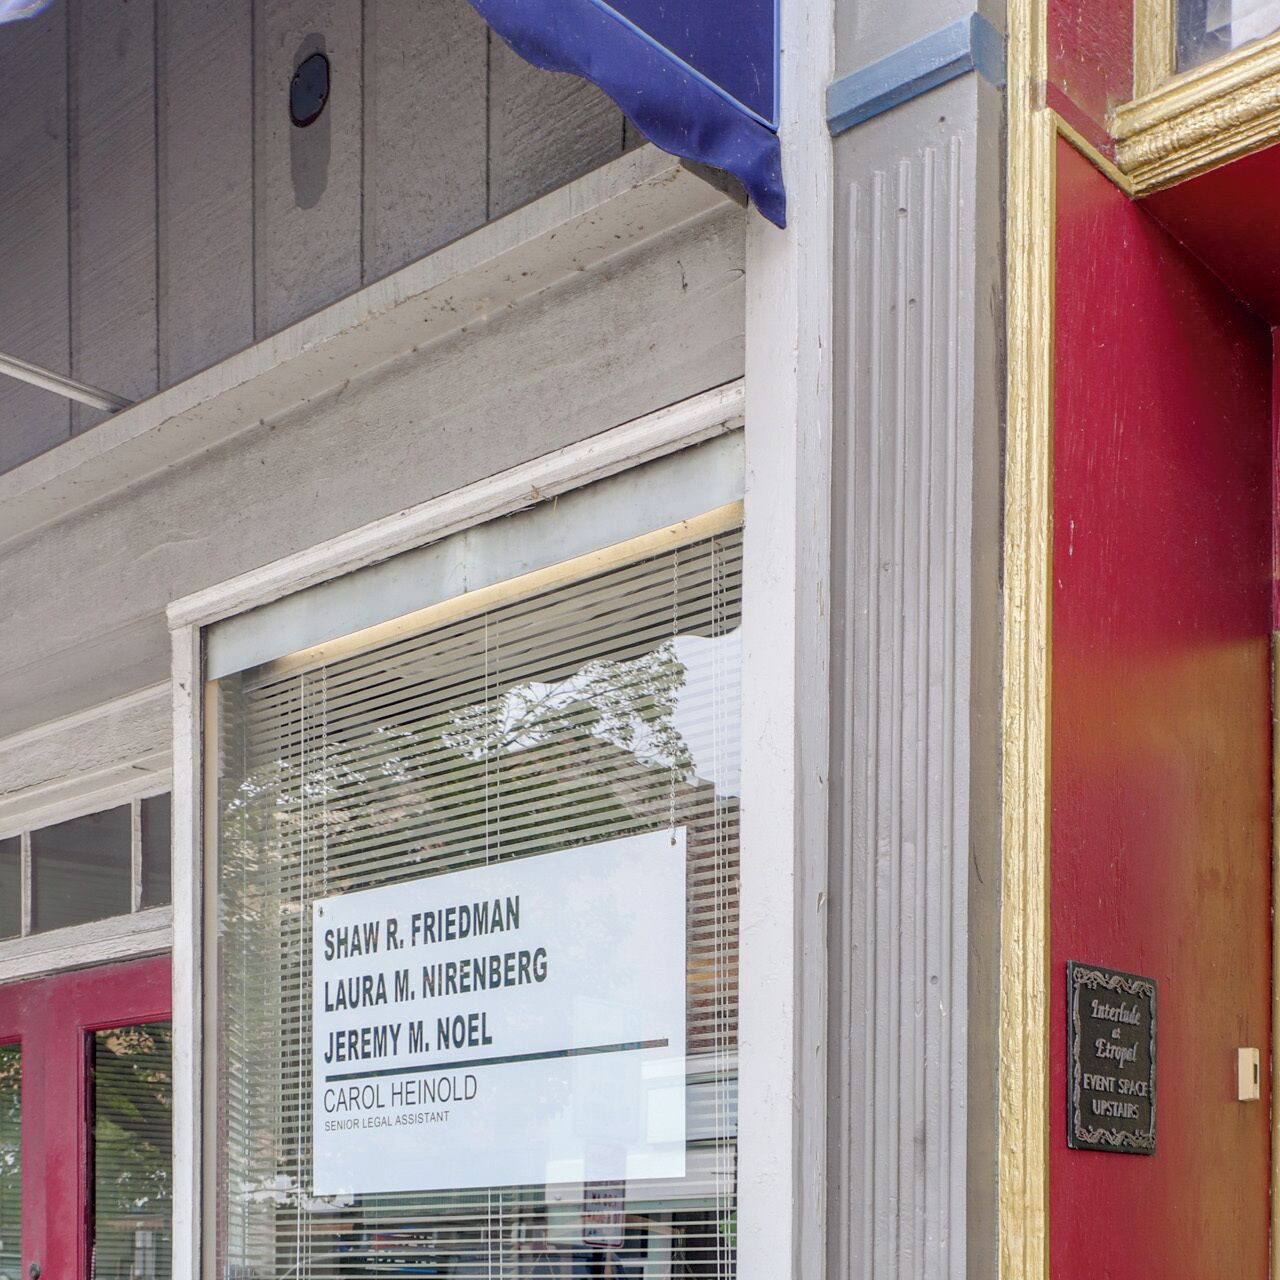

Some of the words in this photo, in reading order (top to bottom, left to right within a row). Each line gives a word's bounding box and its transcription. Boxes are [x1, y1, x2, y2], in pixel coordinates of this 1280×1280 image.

[324, 921, 379, 961] SHAW
[386, 918, 404, 951] R.
[411, 895, 520, 947] FRIEDMAN
[324, 973, 388, 1012] LAURA
[394, 968, 415, 1003] M.
[422, 947, 548, 999] NIRENBERG
[1091, 999, 1141, 1026] Interlude
[324, 1023, 402, 1064] JEREMY
[408, 1020, 430, 1054] M.
[437, 1012, 493, 1051] NOEL
[1111, 1027, 1121, 1039] at
[1095, 1038, 1139, 1069] Etropal
[324, 1083, 386, 1113] CAROL
[391, 1074, 478, 1107] HEINOLD
[1083, 1073, 1116, 1093] EVENT
[1118, 1078, 1148, 1097] SPACE
[324, 1118, 360, 1132] SENIOR
[362, 1115, 393, 1129] LEGAL
[394, 1110, 450, 1126] ASSISTANT
[1092, 1099, 1140, 1120] UPSTAIRS
